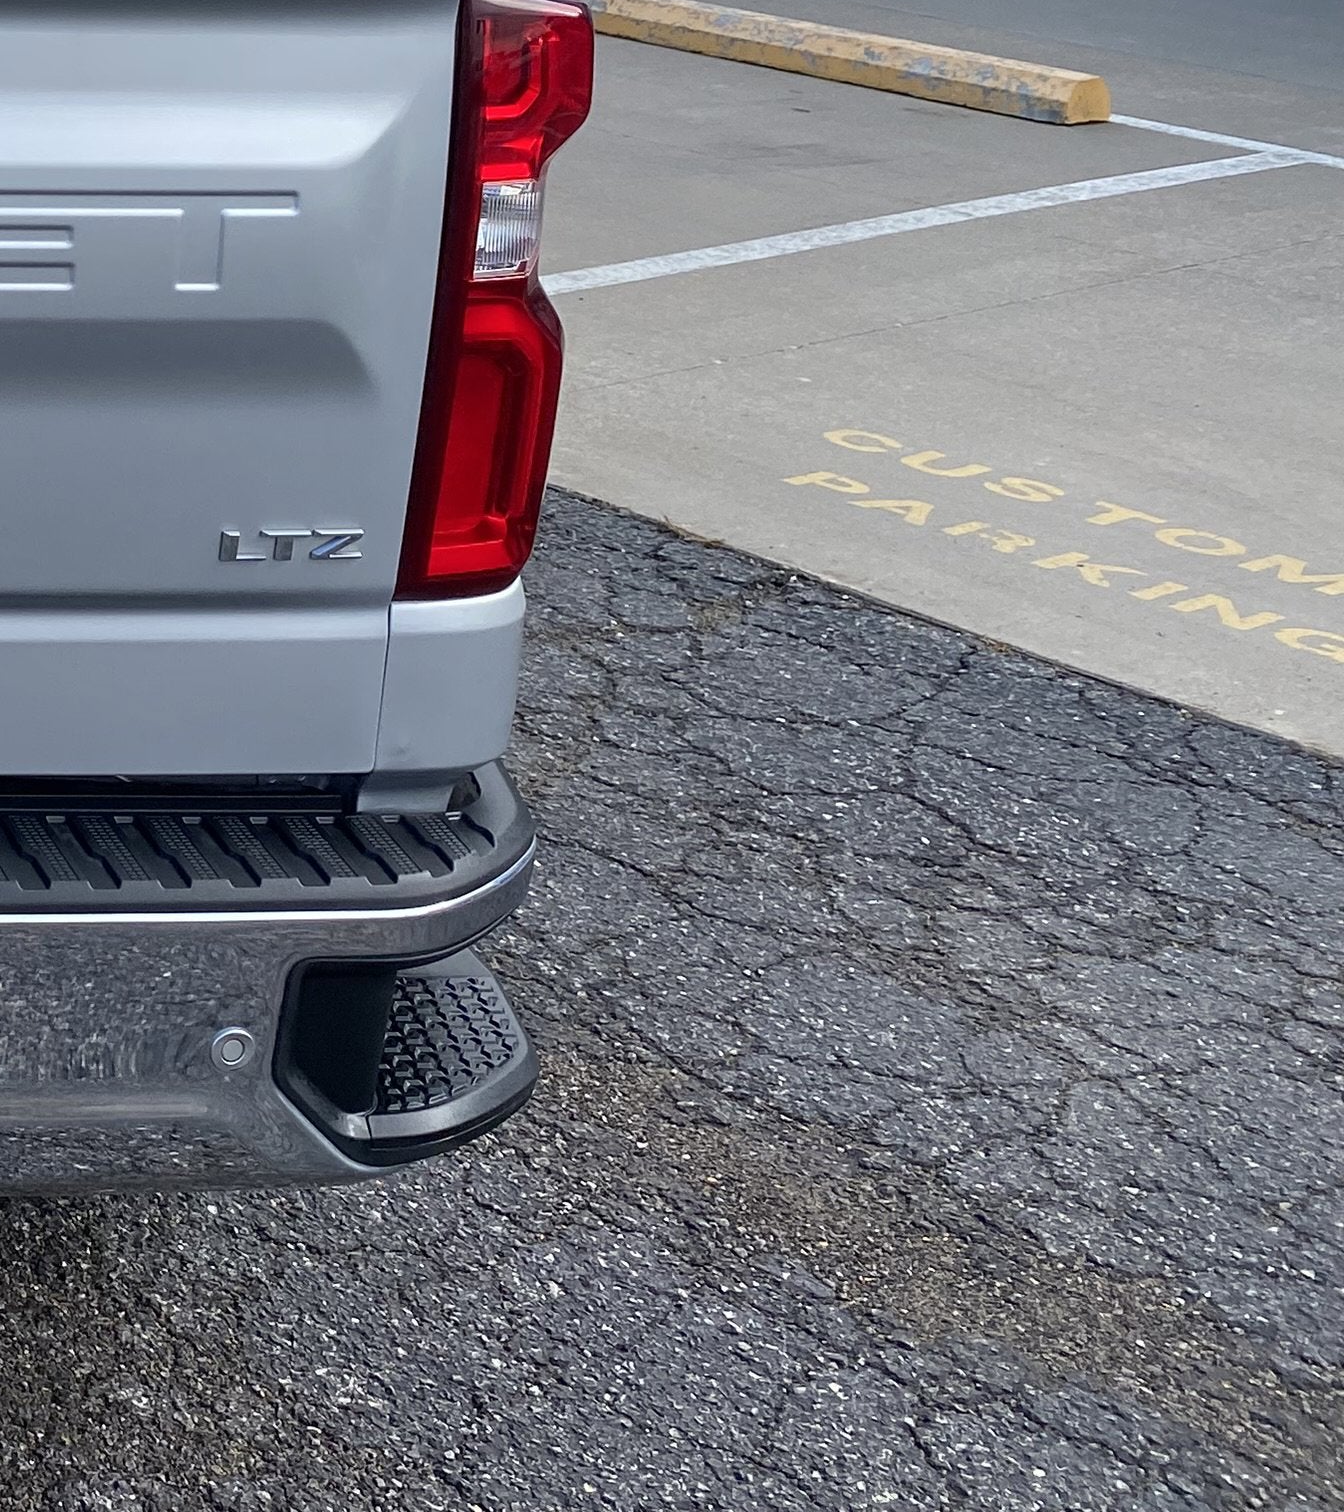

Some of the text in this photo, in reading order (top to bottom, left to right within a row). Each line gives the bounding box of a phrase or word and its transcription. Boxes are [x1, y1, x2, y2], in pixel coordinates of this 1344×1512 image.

[218, 528, 365, 561] LTZ
[782, 470, 1344, 665] PARKING
[822, 428, 1344, 596] CUSTOM
